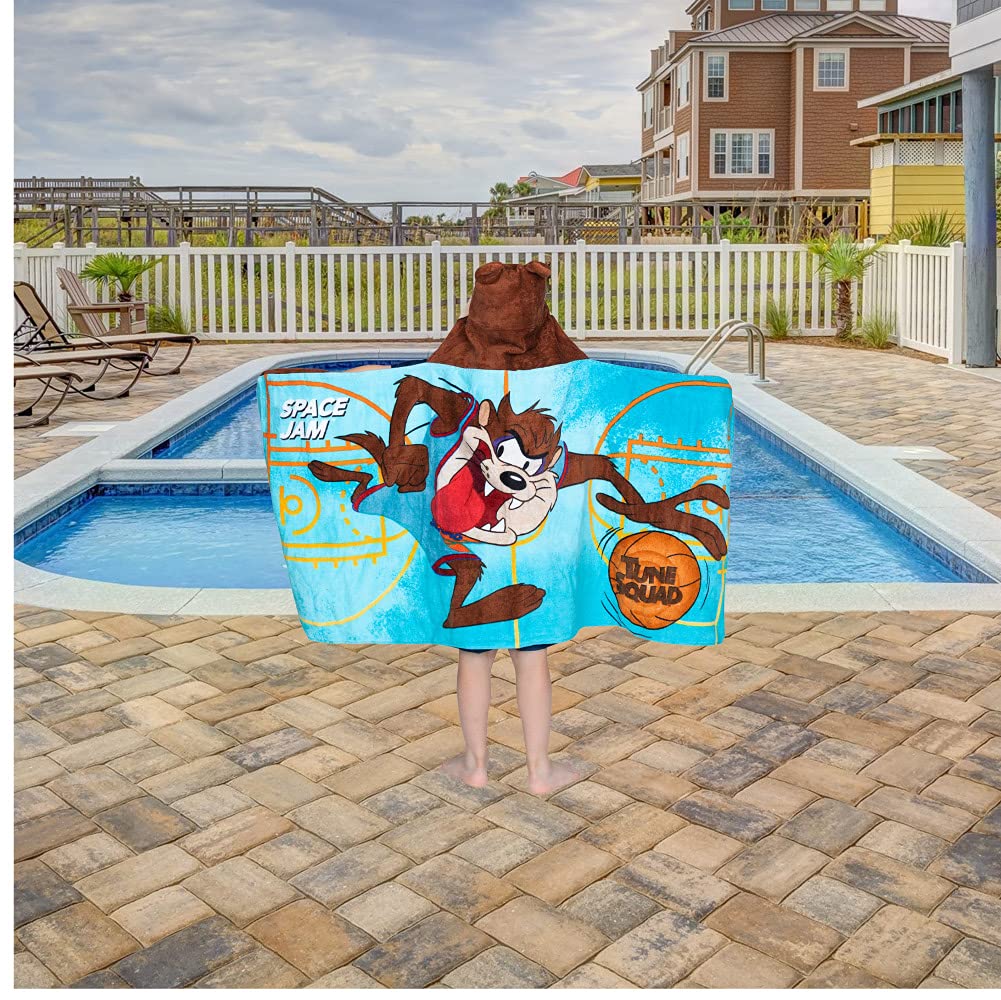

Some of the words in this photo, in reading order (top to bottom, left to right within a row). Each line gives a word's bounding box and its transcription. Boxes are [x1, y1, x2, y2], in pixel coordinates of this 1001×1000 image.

[280, 397, 350, 419] SPACE
[280, 420, 330, 440] JAM
[620, 555, 677, 585] TUNE
[616, 571, 683, 605] SQUAD
